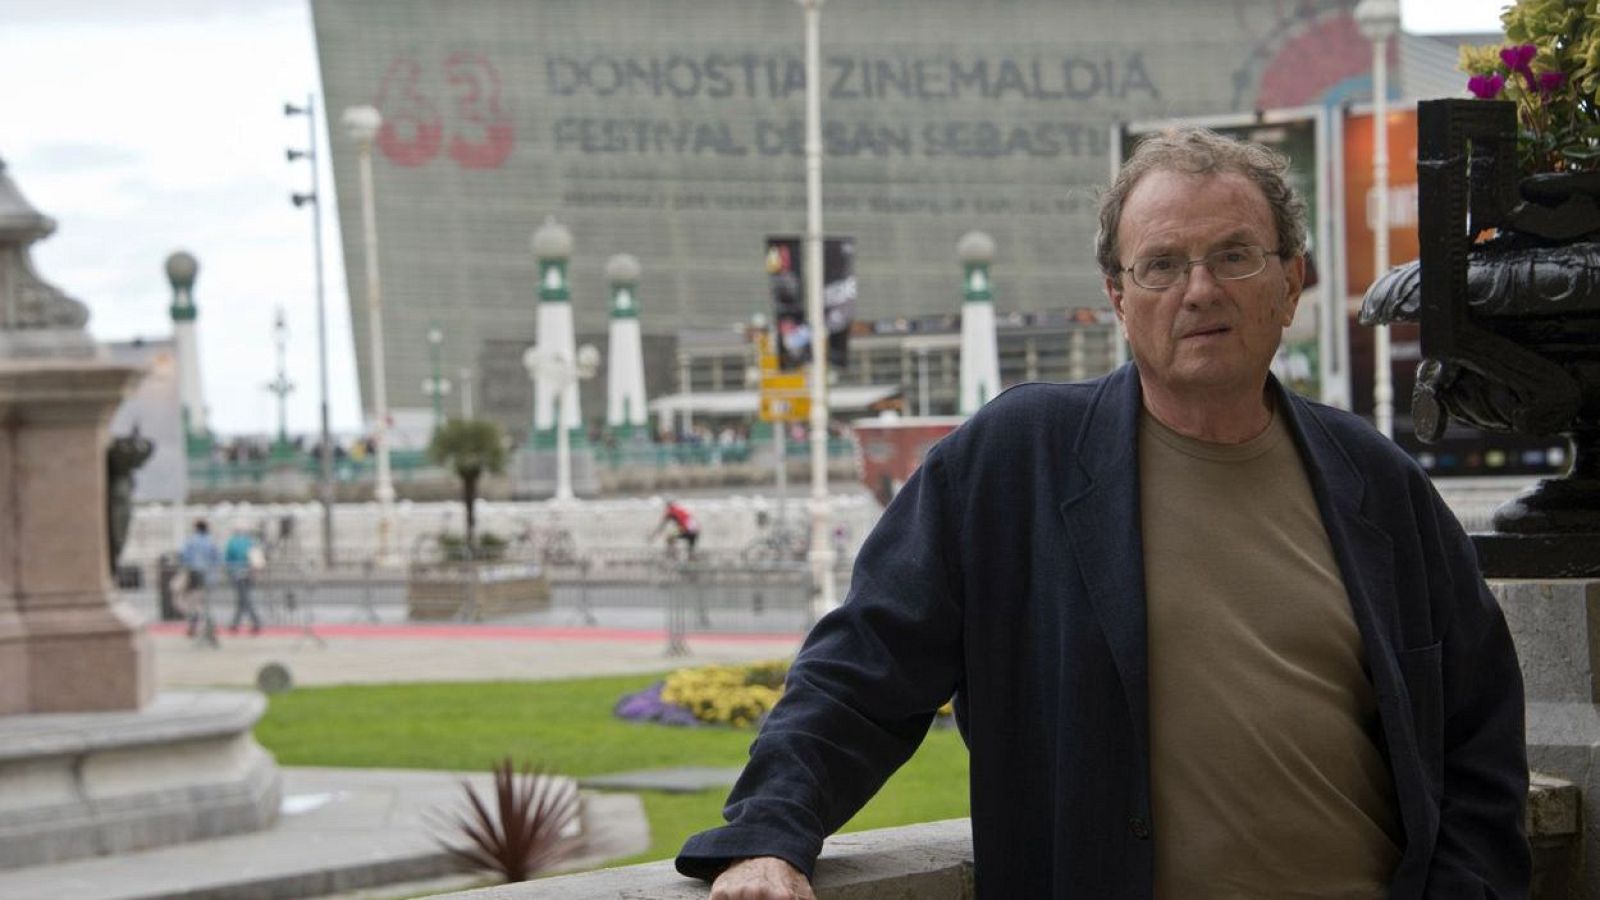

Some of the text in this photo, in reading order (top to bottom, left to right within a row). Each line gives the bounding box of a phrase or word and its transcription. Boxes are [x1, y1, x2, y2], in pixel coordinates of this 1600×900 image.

[546, 54, 1160, 99] DONOSTIA ZINEMALDIA
[375, 52, 513, 170] 63
[554, 117, 1110, 158] FESTIVAL DE SAN SEBASTI
